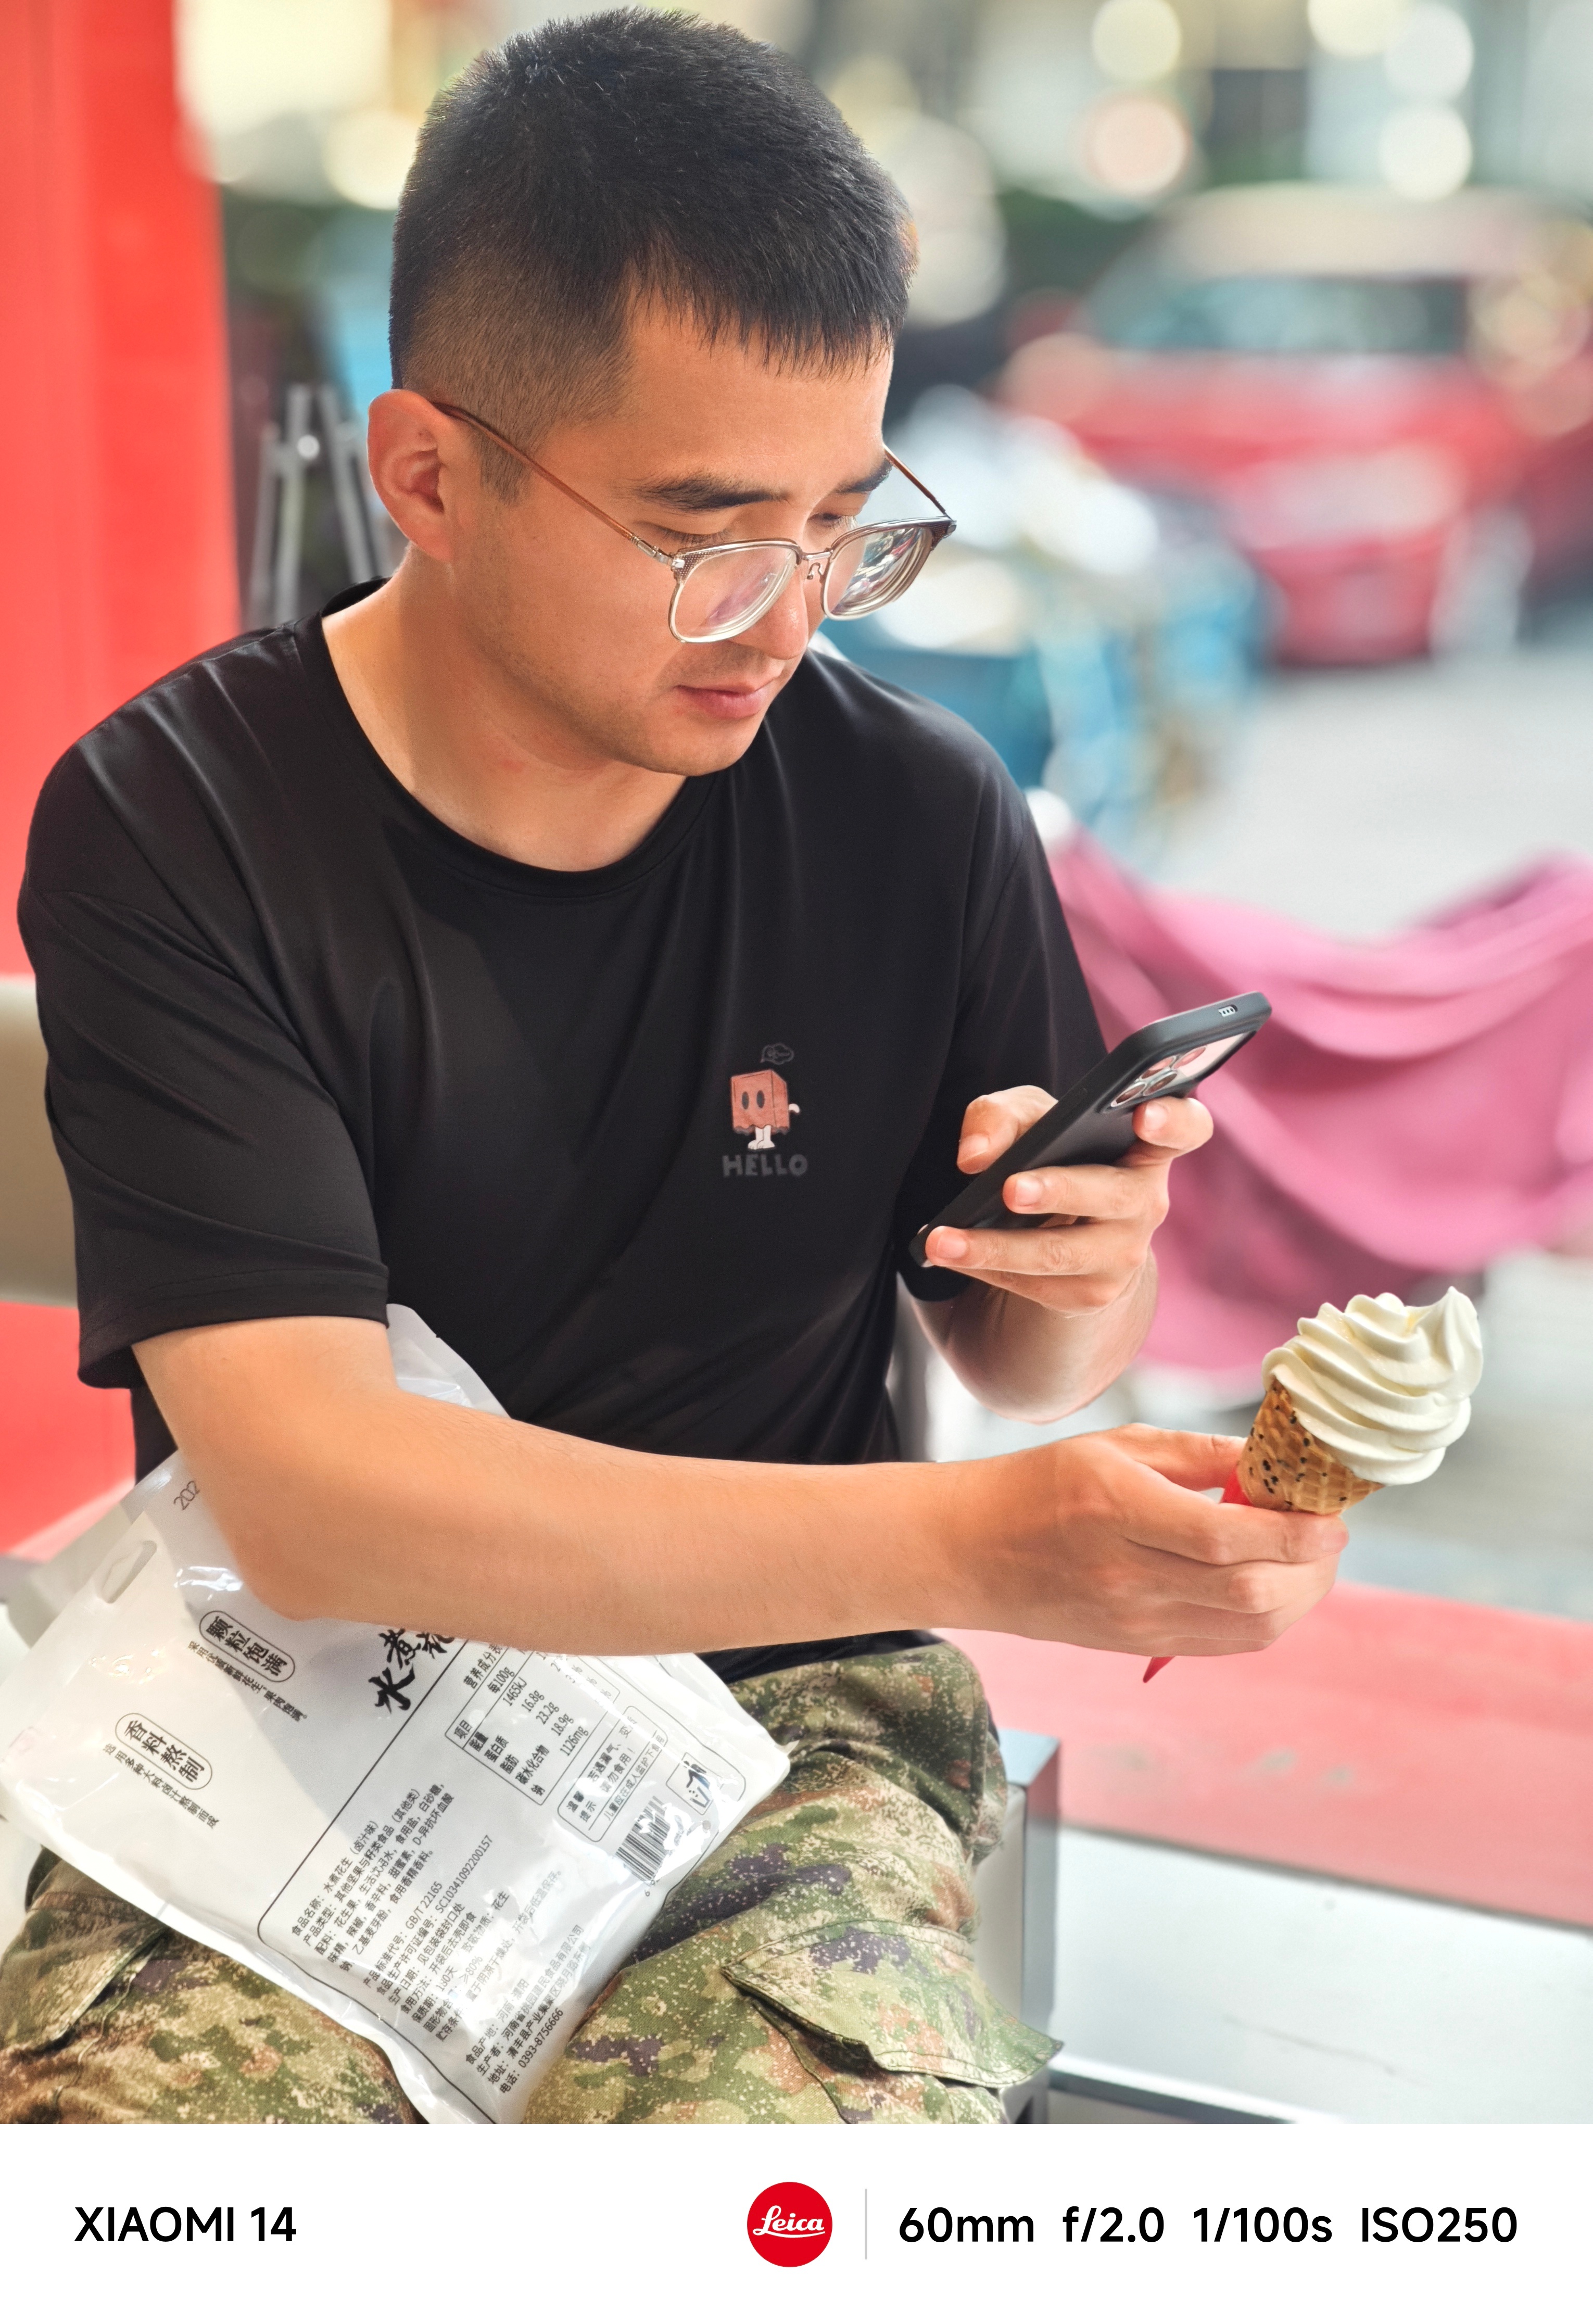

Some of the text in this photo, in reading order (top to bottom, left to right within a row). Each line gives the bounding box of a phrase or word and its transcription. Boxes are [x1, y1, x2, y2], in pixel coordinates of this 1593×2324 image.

[722, 1153, 807, 1177] HELLO
[205, 1614, 288, 1678] 颗粒饱满
[452, 1665, 515, 1740] 项目 每100g
[501, 1676, 528, 1707] 1465kJ
[121, 1717, 206, 1785] 香料熬制
[484, 1734, 509, 1763] 蛋白质
[521, 1689, 545, 1713] 16.8g
[499, 1753, 520, 1775] 脂肪
[535, 1700, 560, 1725] 23.2g
[514, 1712, 575, 1786] 碳水化合物 18.9g
[559, 1724, 589, 1757] 1126mg
[102, 1741, 220, 1829] 选用多种大料卤汁熬制而成
[578, 1800, 598, 1823] 提示
[420, 1880, 444, 1909] 22165
